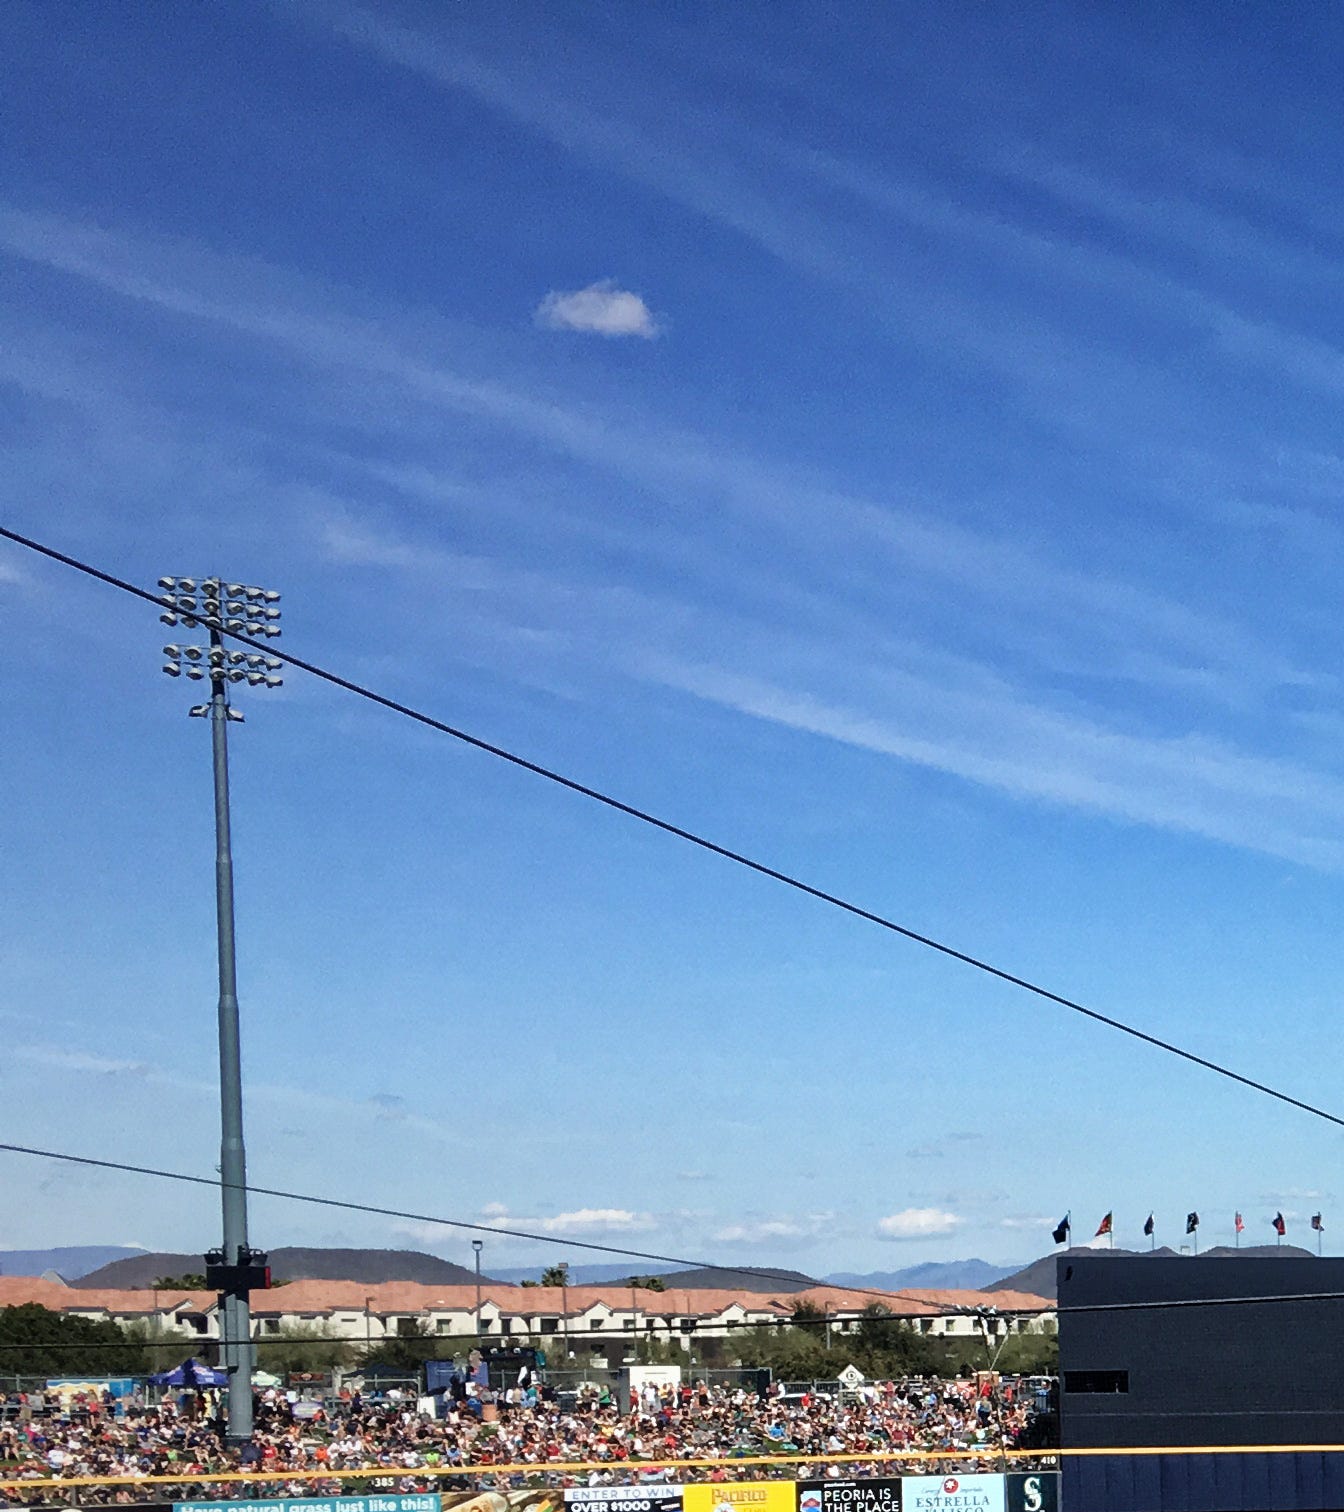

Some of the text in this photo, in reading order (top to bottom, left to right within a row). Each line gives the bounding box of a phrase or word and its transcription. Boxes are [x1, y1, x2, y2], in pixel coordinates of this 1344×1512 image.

[375, 1477, 394, 1487] 385
[572, 1487, 675, 1500] ENTER TO WIN
[823, 1488, 892, 1502] PEORIA IS
[369, 1498, 397, 1512] like
[401, 1497, 434, 1511] this!
[611, 1501, 651, 1512] $1000
[856, 1500, 900, 1512] PLACE
[916, 1495, 990, 1508] ESTRELLA
